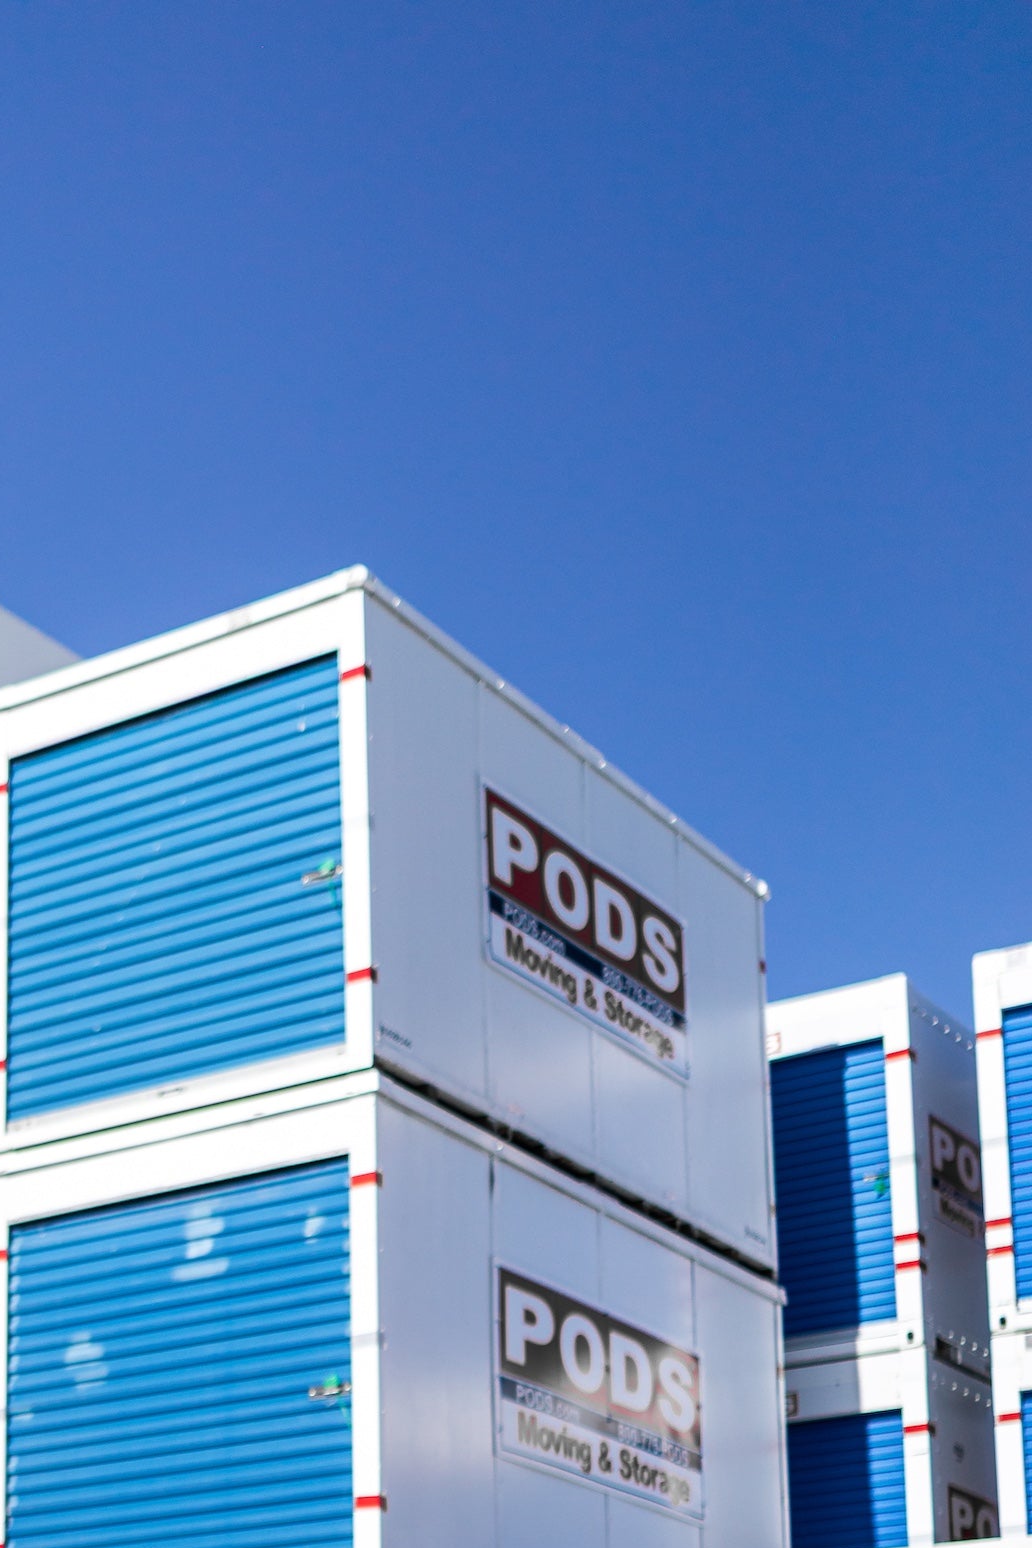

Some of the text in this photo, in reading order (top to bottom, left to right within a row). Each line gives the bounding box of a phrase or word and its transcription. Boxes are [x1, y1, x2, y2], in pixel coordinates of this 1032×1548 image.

[491, 806, 679, 993] PODS
[505, 927, 577, 1006] Moving
[583, 978, 598, 1011] &
[932, 1124, 980, 1192] PO
[505, 1284, 695, 1432] PODS
[518, 1411, 591, 1474] Moving
[598, 1441, 613, 1474] &
[951, 1496, 998, 1540] PO
